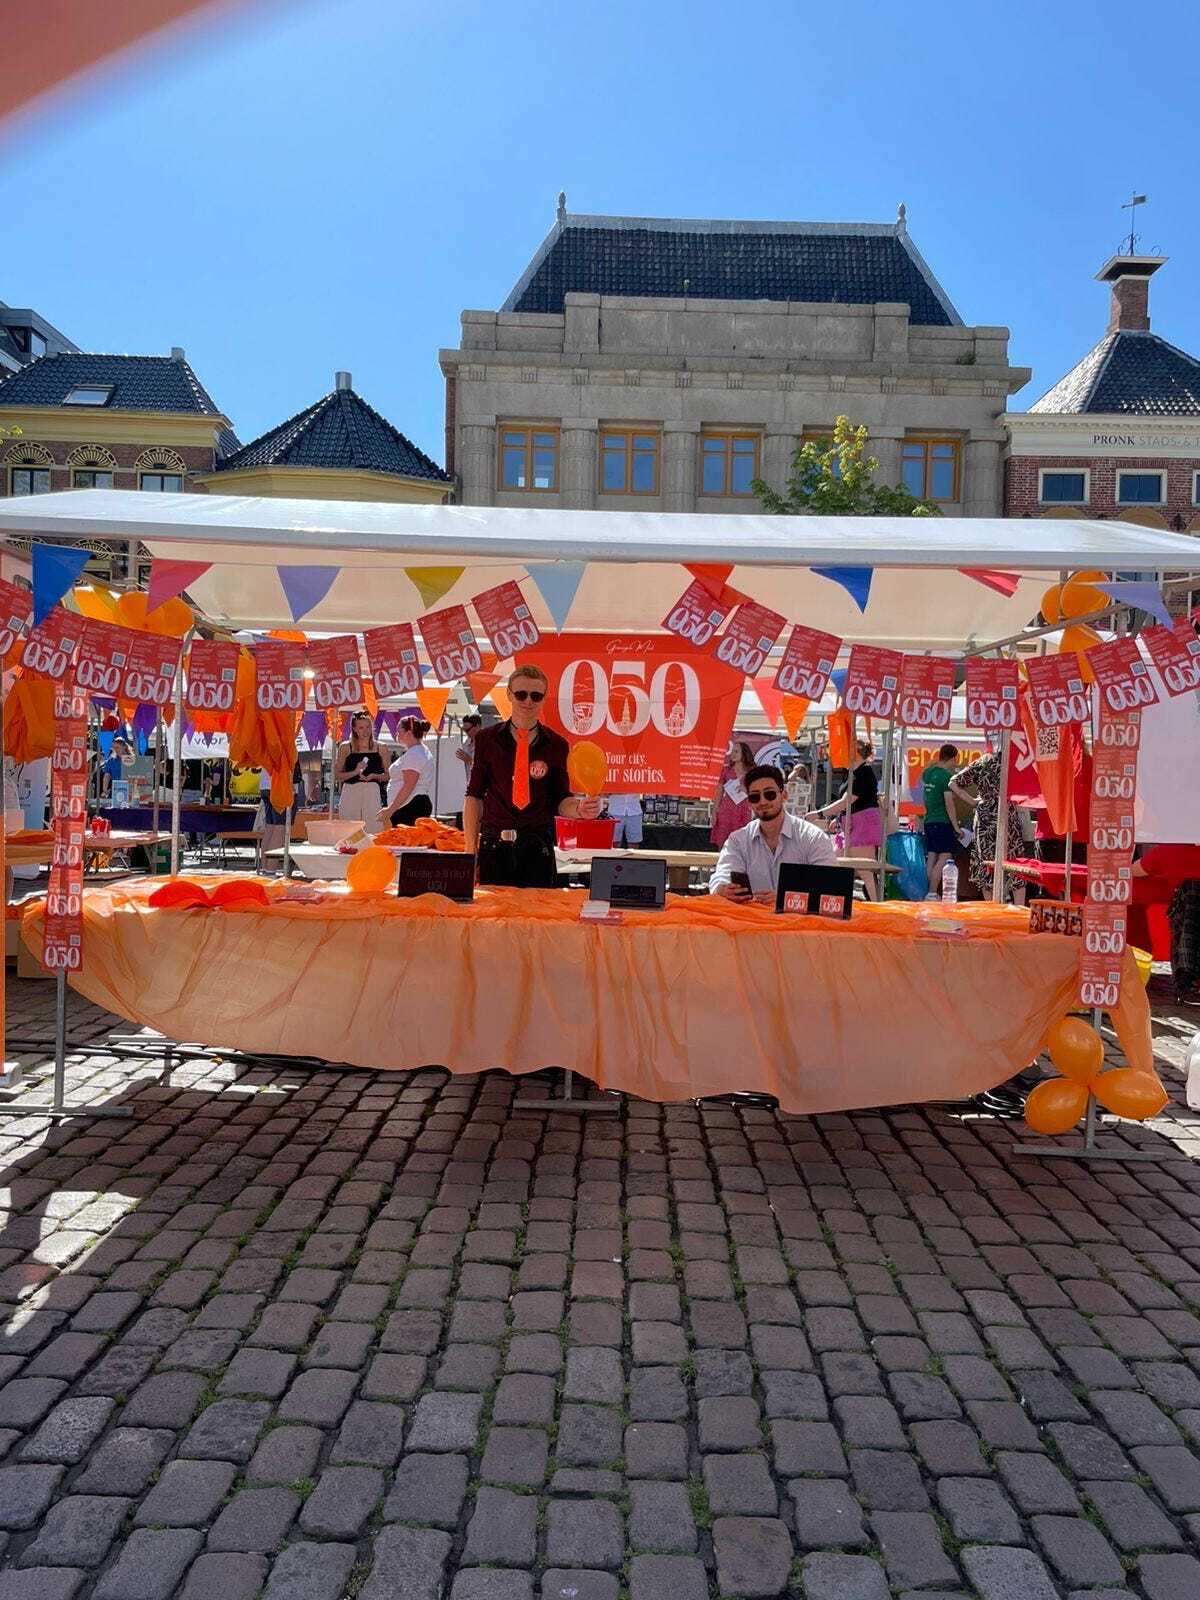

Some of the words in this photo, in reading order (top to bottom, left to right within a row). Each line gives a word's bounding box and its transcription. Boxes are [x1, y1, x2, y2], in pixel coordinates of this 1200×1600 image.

[1093, 435, 1135, 445] PRONK
[494, 620, 539, 657] 050
[668, 607, 713, 646] 050
[24, 641, 67, 677] 050
[435, 646, 481, 681] 050
[716, 636, 763, 673] 050
[76, 660, 121, 693] 050
[125, 672, 170, 704] 050
[374, 664, 420, 696] 050
[779, 664, 825, 698] 050
[189, 681, 233, 709] 050
[257, 682, 303, 709] 050
[316, 677, 361, 707] 050
[558, 659, 701, 737] 050
[846, 685, 893, 716] 050
[1106, 676, 1155, 711] 050
[901, 697, 949, 726] 050
[968, 700, 1017, 727] 050
[1039, 695, 1087, 726] 050
[1103, 724, 1138, 746] 050
[605, 752, 627, 765] Your
[628, 752, 648, 767] city.
[605, 768, 619, 783] ur
[623, 766, 667, 783] stories.
[1095, 775, 1133, 798] 050
[1093, 828, 1131, 850] 050
[1091, 879, 1129, 901] 050
[47, 895, 79, 917] 050
[1086, 931, 1124, 953] 050
[45, 947, 80, 968] 050
[1081, 983, 1118, 1005] 050
